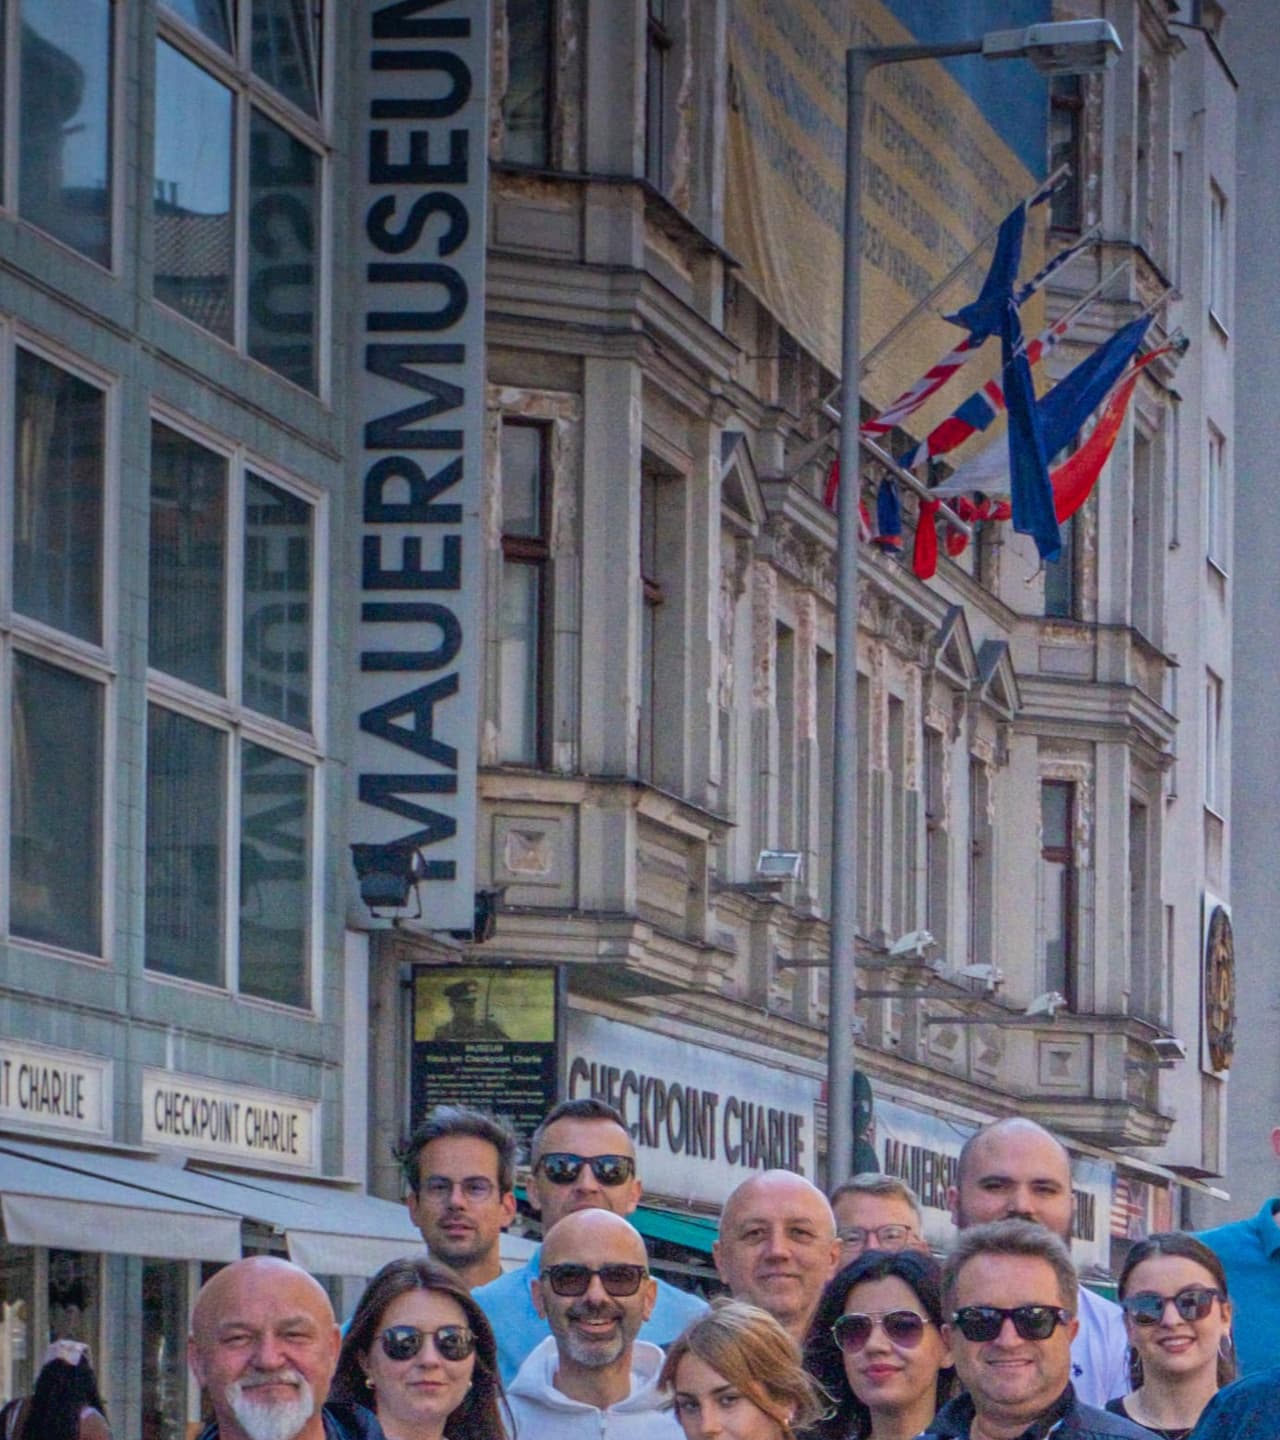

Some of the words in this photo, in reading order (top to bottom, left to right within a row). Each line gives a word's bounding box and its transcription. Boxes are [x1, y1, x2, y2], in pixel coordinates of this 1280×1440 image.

[18, 1064, 84, 1119] CHARLIE
[154, 1090, 240, 1144] CHECKPOINT
[245, 1107, 297, 1154] CHARLIE
[724, 1096, 804, 1175] CHARLIE
